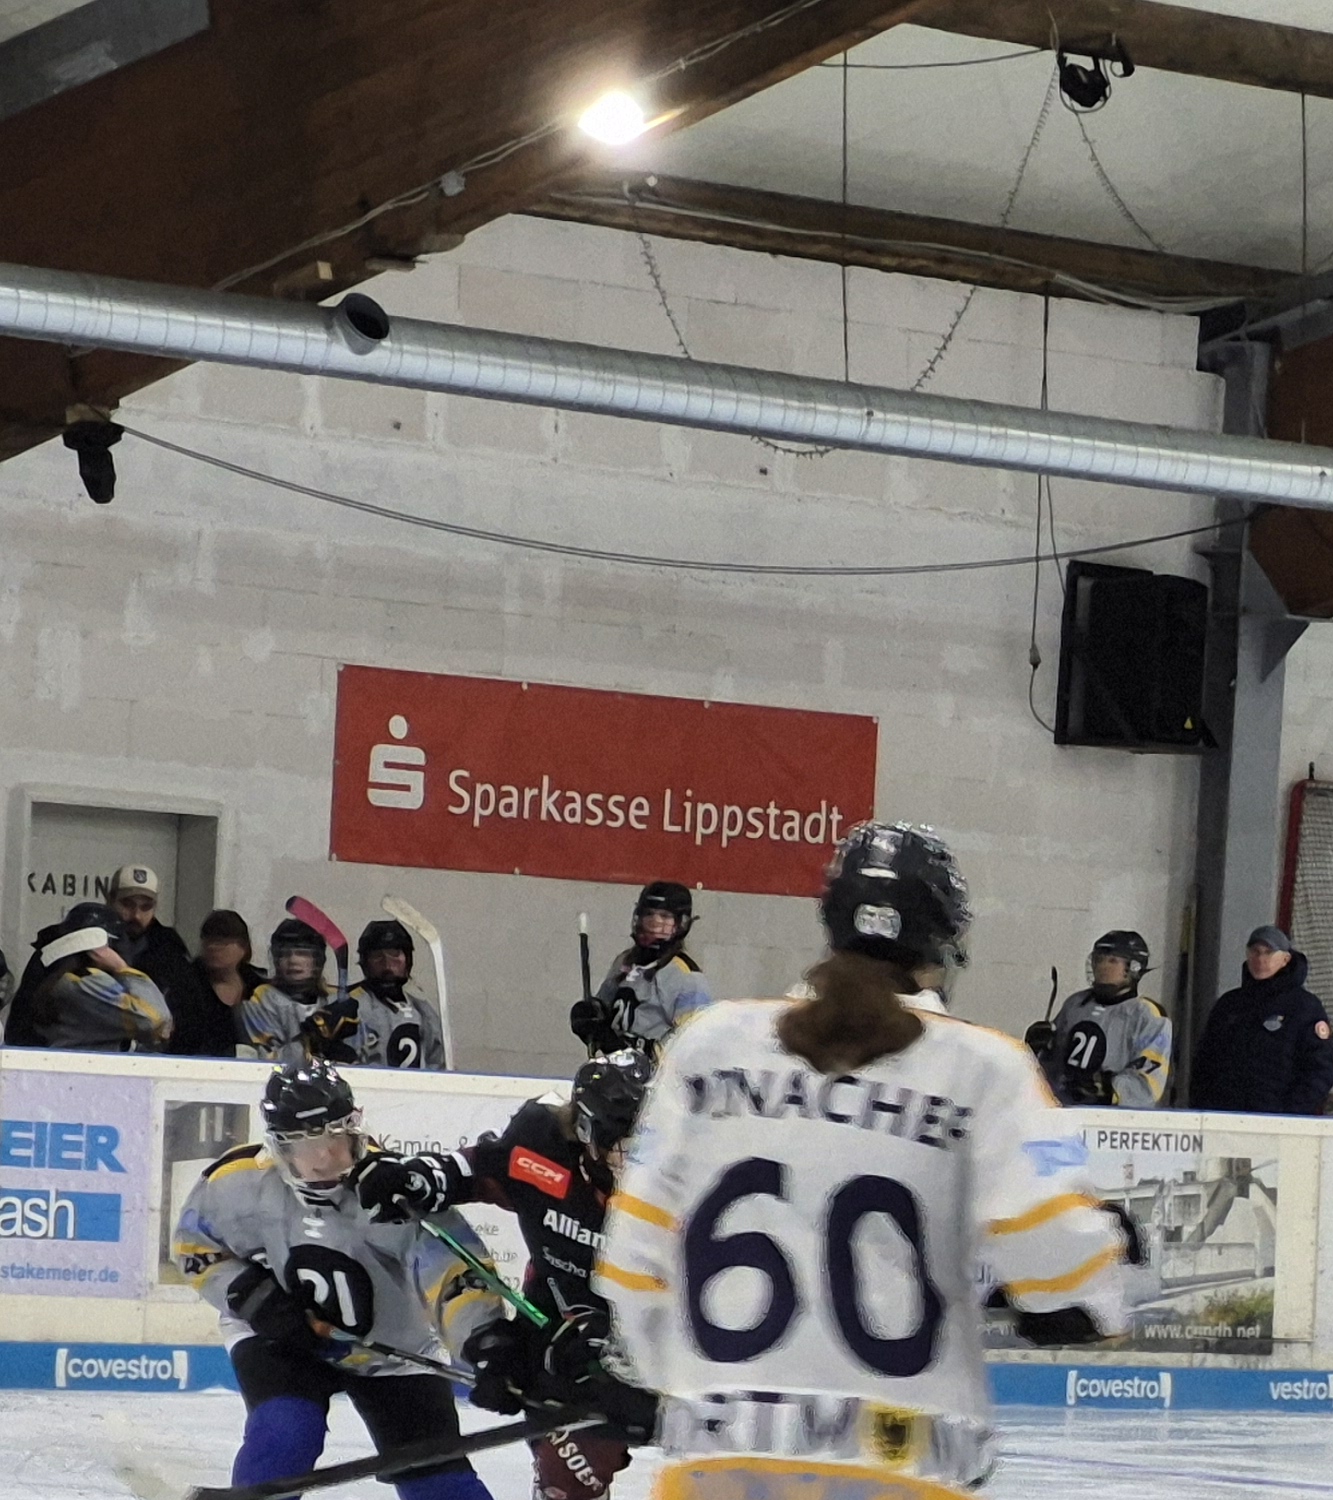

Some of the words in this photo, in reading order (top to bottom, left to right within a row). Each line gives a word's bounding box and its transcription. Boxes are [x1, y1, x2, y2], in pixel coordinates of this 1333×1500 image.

[447, 769, 650, 830] Sparkasse
[663, 788, 846, 848] Lippstadt
[1067, 1031, 1098, 1069] 21
[1097, 1130, 1204, 1153] PERFEKTION
[685, 1157, 943, 1377] 60
